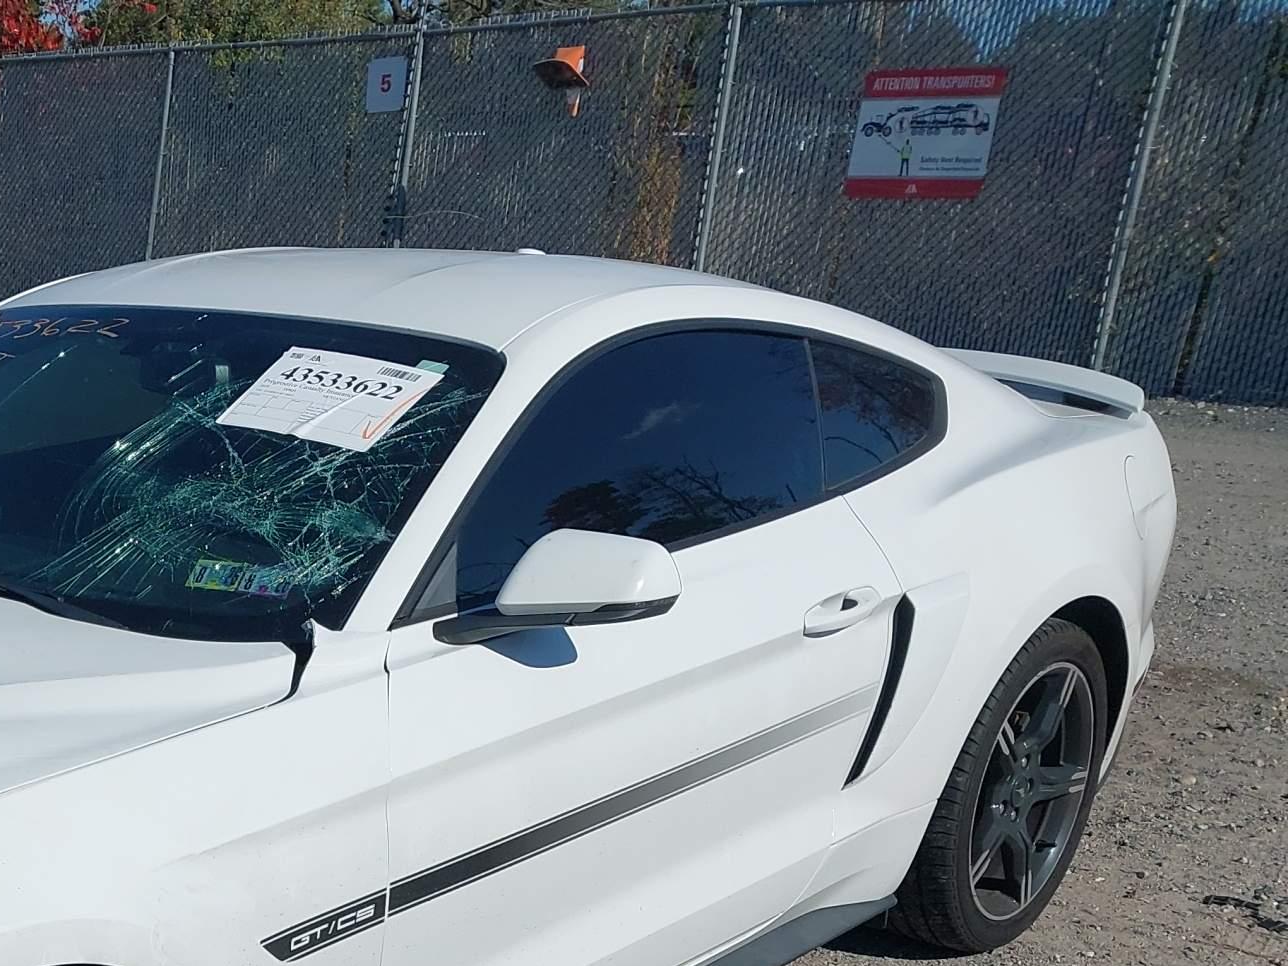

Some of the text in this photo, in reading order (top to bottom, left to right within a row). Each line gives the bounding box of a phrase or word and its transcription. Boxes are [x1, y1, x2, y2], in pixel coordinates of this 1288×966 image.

[380, 73, 392, 93] 5
[872, 75, 996, 91] ATTENTION TRANSPORTERS!
[280, 366, 403, 400] 43533622
[290, 903, 376, 951] GT/CS
